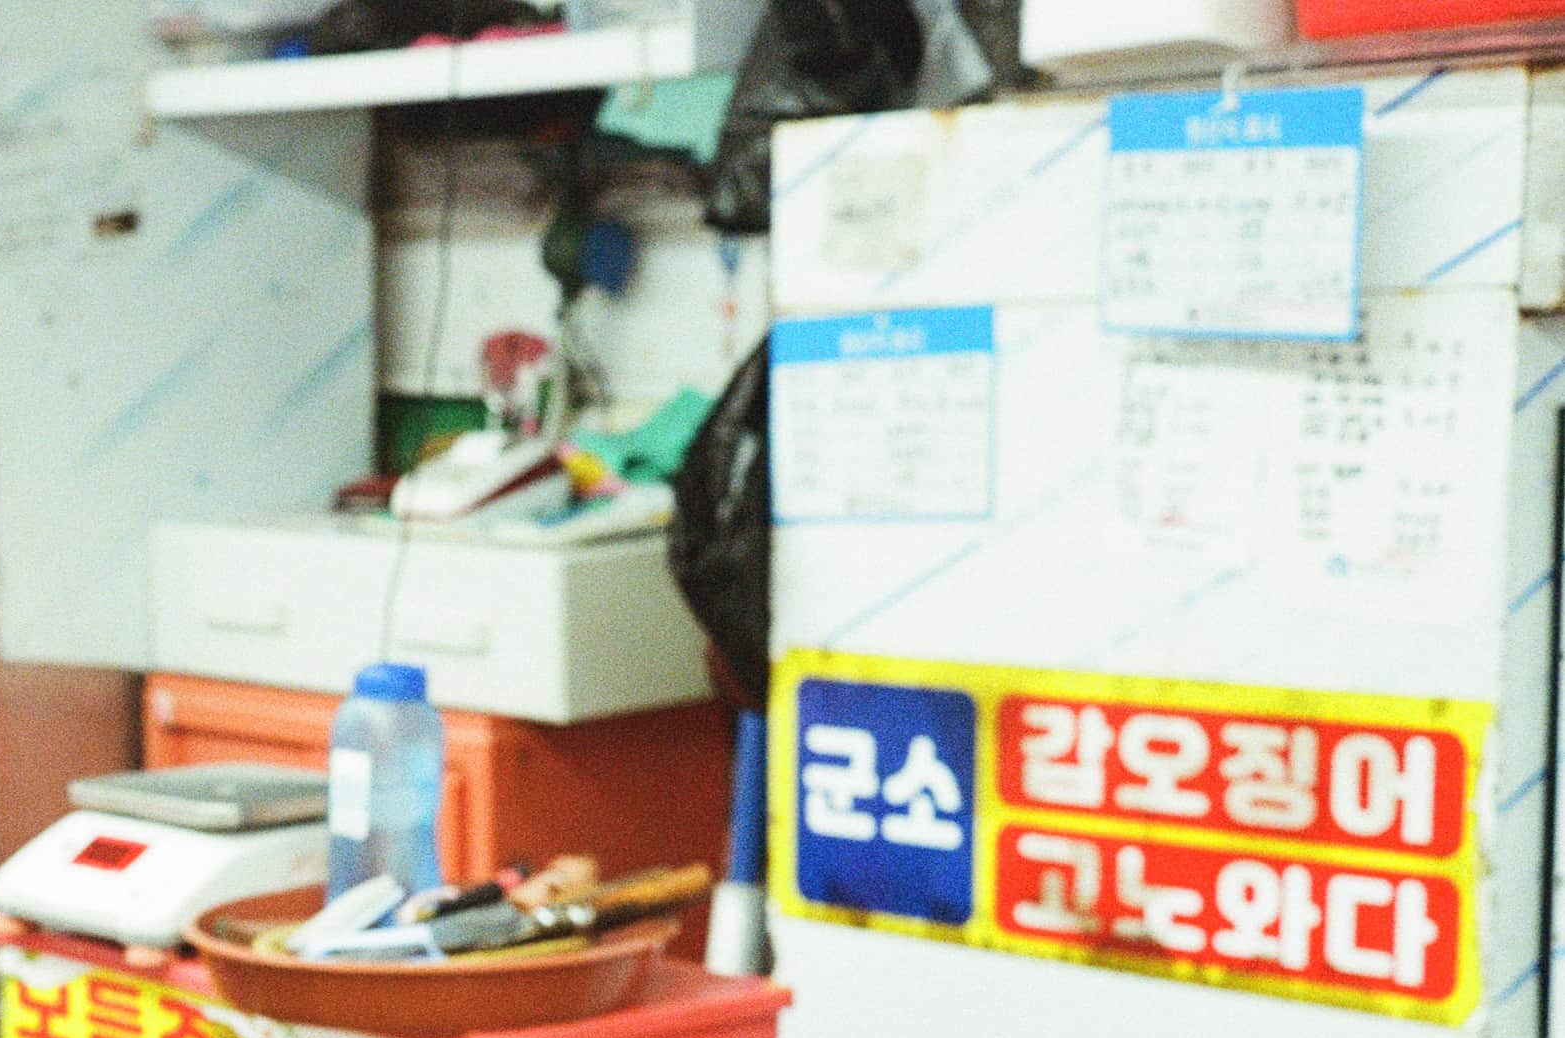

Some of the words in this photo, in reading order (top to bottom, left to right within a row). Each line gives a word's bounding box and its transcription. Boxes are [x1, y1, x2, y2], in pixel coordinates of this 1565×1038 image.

[802, 725, 963, 851] 군소
[1021, 703, 1436, 846] 갑오징어
[1012, 832, 1439, 988] 고노와다
